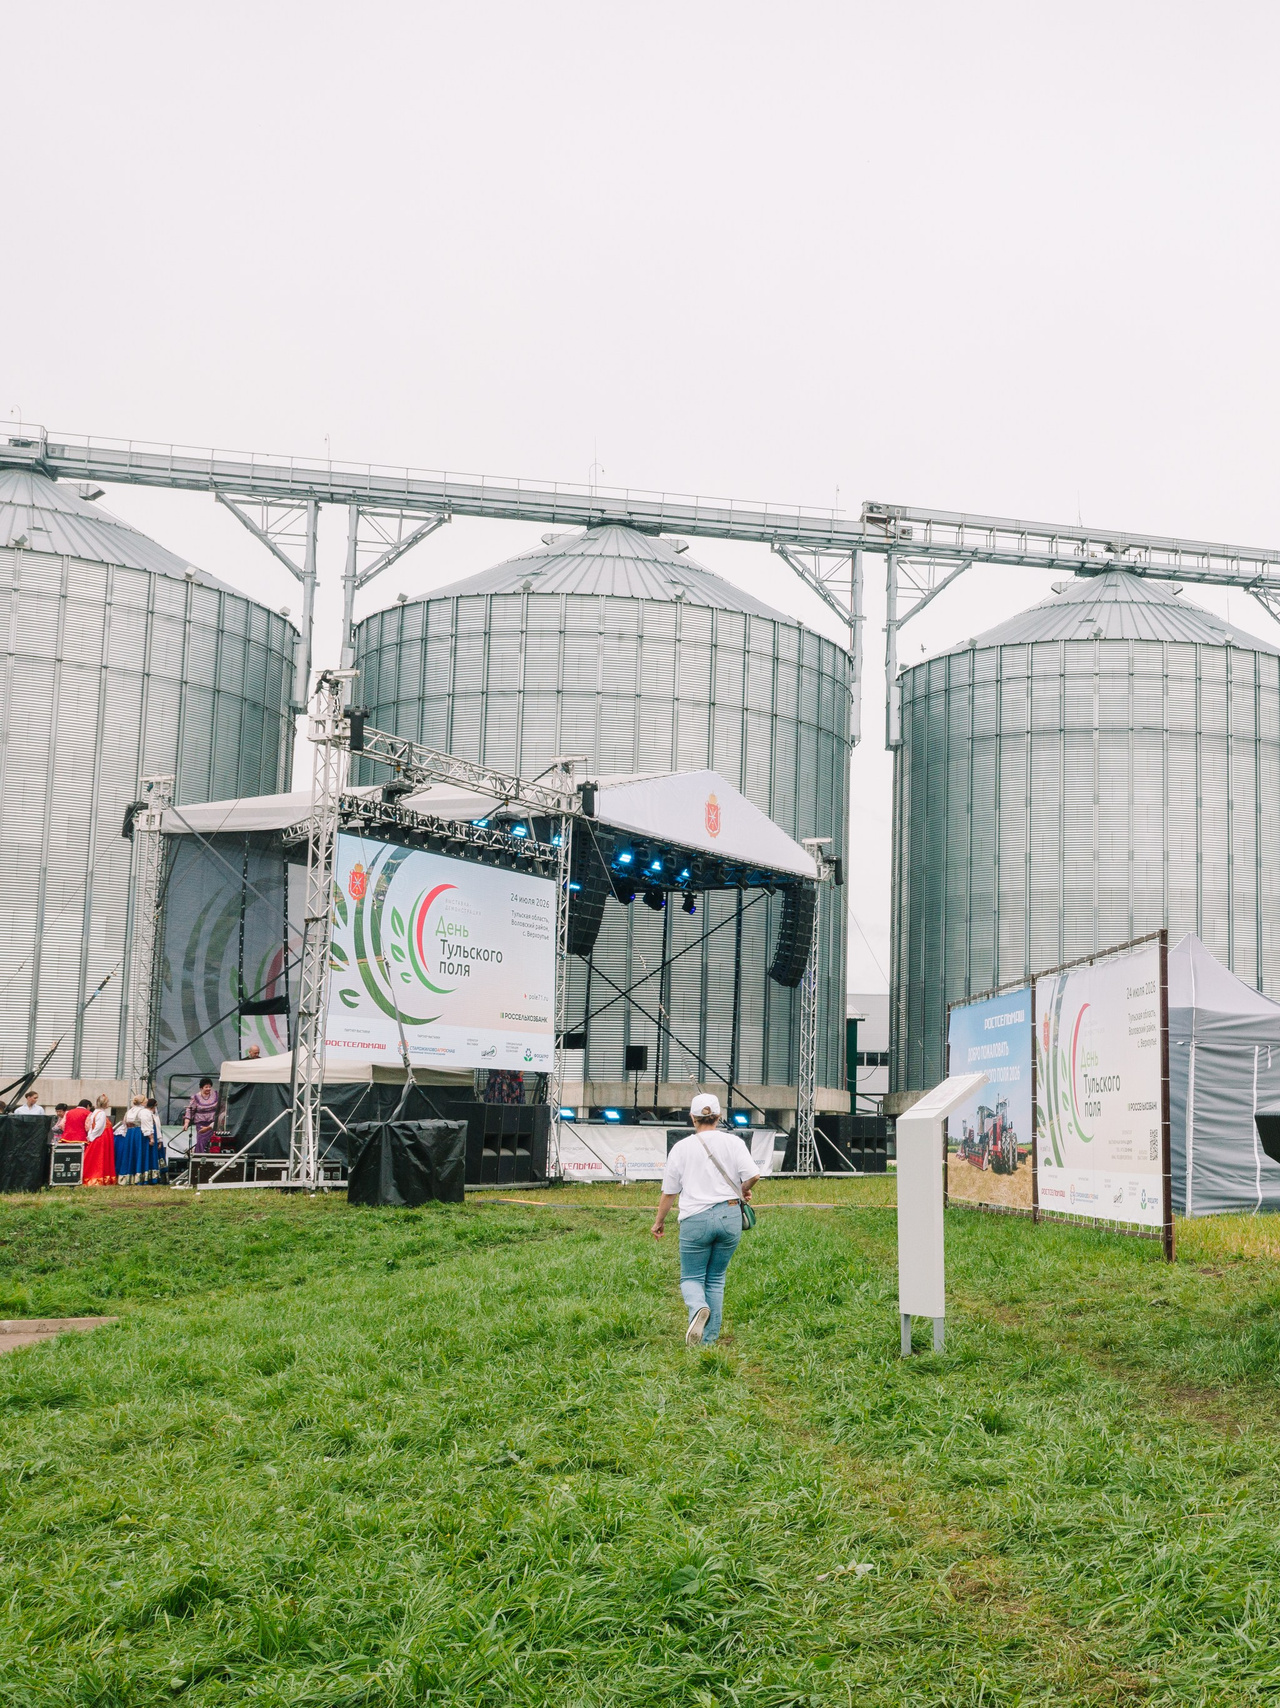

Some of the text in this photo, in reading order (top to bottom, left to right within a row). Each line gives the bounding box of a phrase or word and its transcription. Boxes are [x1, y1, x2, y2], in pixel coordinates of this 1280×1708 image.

[510, 892, 550, 909] 24 июля 2026
[511, 910, 531, 921] Тульская
[435, 915, 469, 938] День
[440, 938, 503, 963] Тульского
[439, 960, 471, 977] поля
[504, 1012, 548, 1023] РОССЕЛЬХОЗБАНК
[984, 1009, 1025, 1031] РОСТСЕЛЬМАШ
[325, 1039, 387, 1050] РОСТСЕЛЬМАШ
[1081, 1045, 1099, 1070] День
[1083, 1074, 1121, 1098] Тульского
[1084, 1101, 1102, 1118] поля
